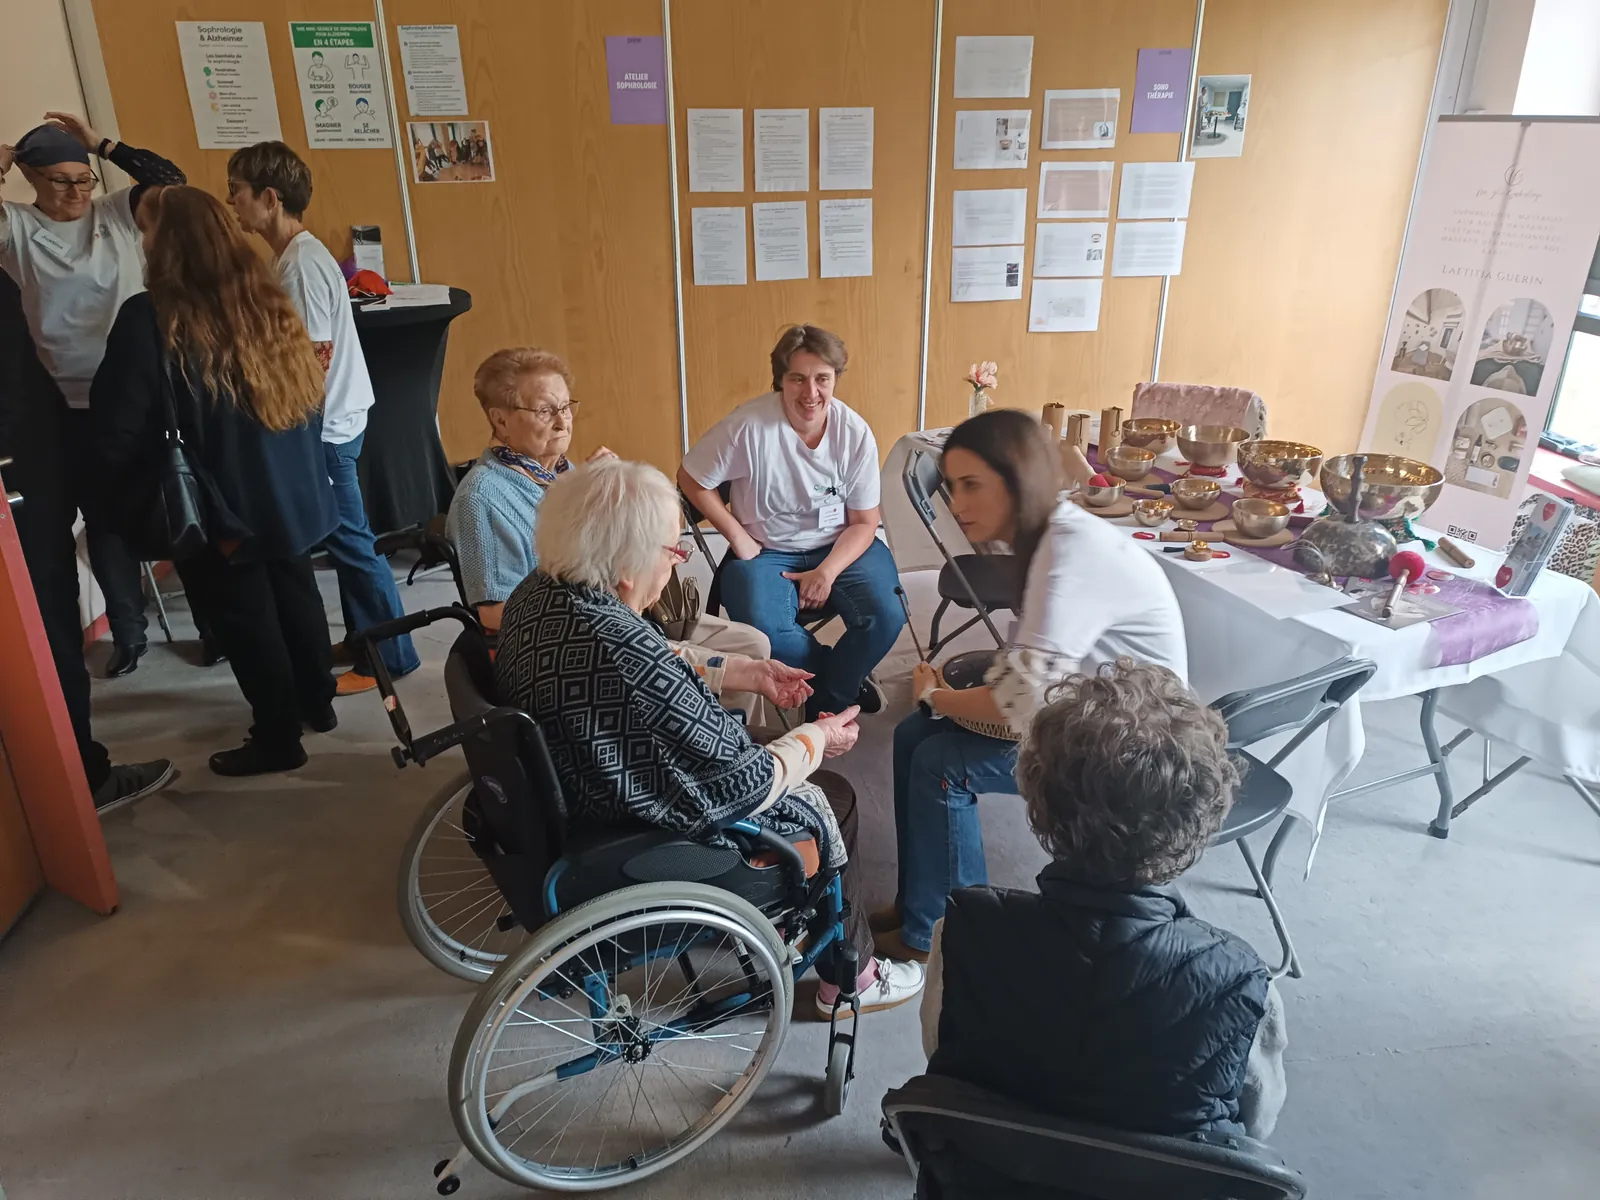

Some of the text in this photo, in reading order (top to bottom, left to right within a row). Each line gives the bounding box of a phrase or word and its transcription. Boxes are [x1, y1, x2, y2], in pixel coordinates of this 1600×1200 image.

[197, 25, 243, 35] Sophrologie
[199, 34, 243, 42] & Alzheimer
[624, 72, 649, 81] ATELIER
[616, 81, 658, 90] SOPHROLOGIE
[1146, 90, 1175, 100] THÉRAPIE
[1441, 264, 1493, 280] LAETITIA
